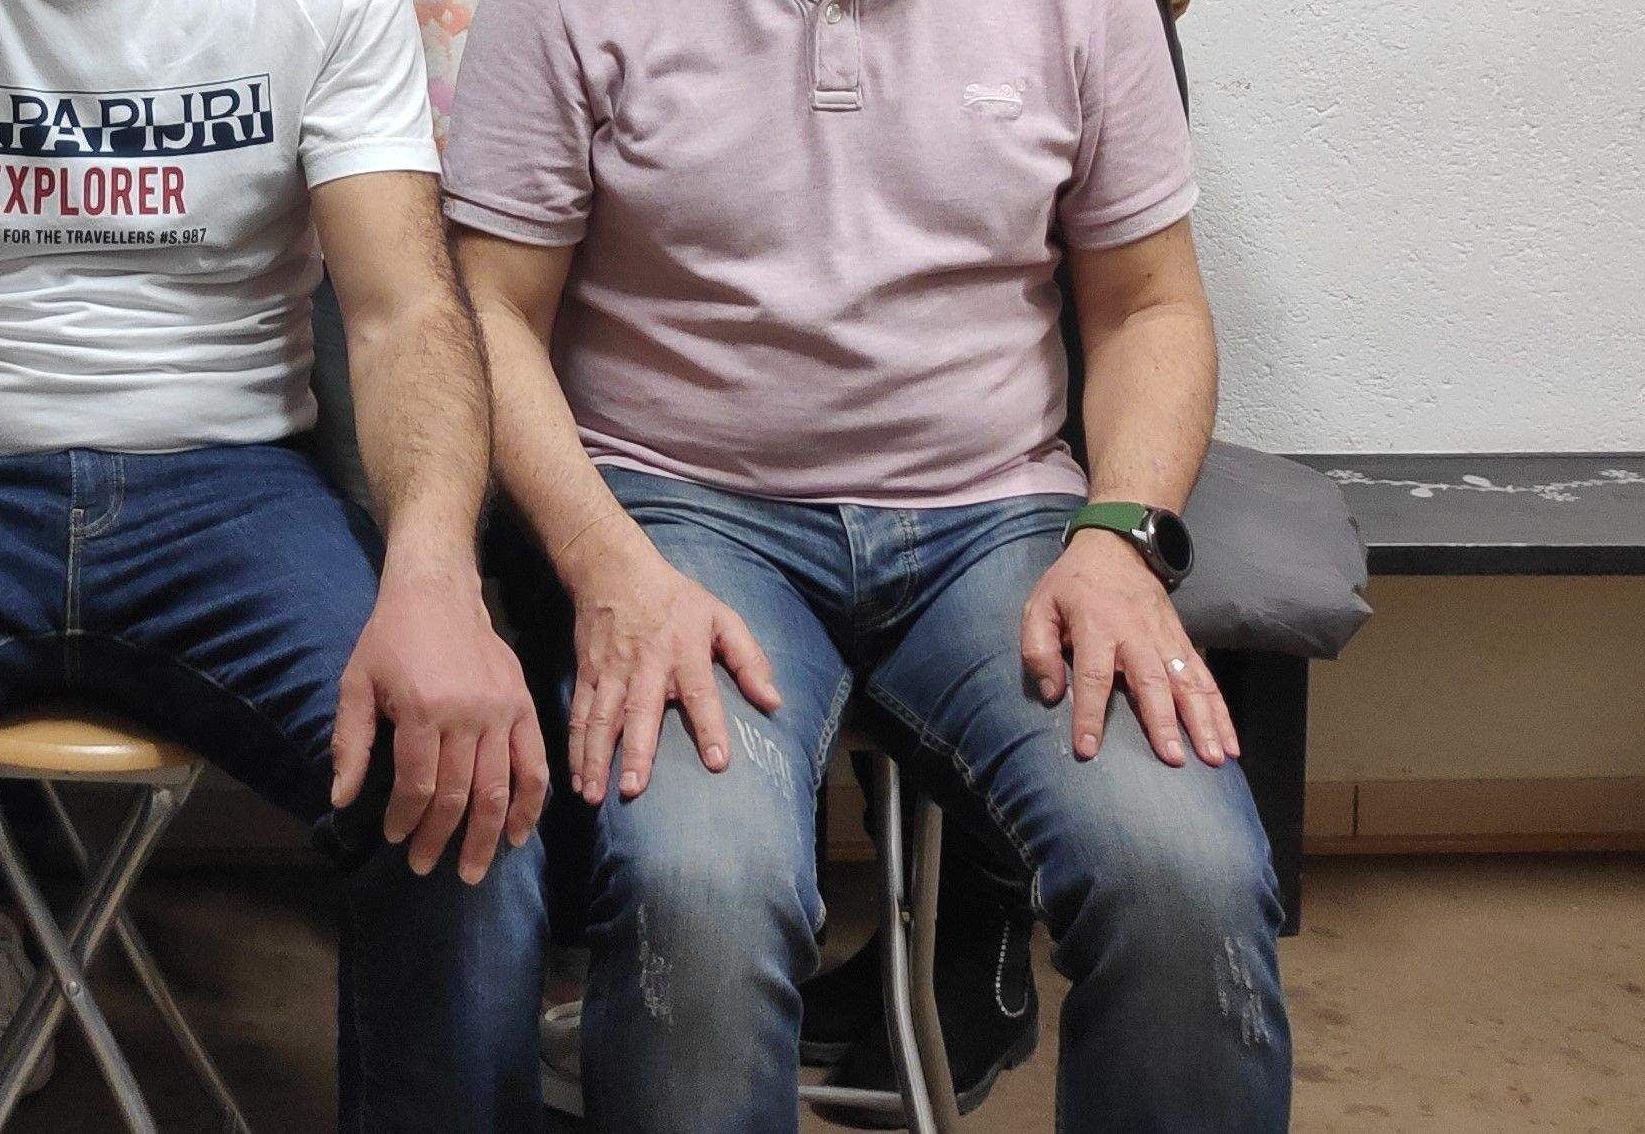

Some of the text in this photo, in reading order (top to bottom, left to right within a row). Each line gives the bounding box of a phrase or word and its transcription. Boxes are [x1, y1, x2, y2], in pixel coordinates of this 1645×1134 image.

[3, 227, 31, 244] FOR
[34, 229, 62, 245] THE
[67, 228, 156, 246] TRAVELLERS
[158, 226, 207, 245] #S.987
